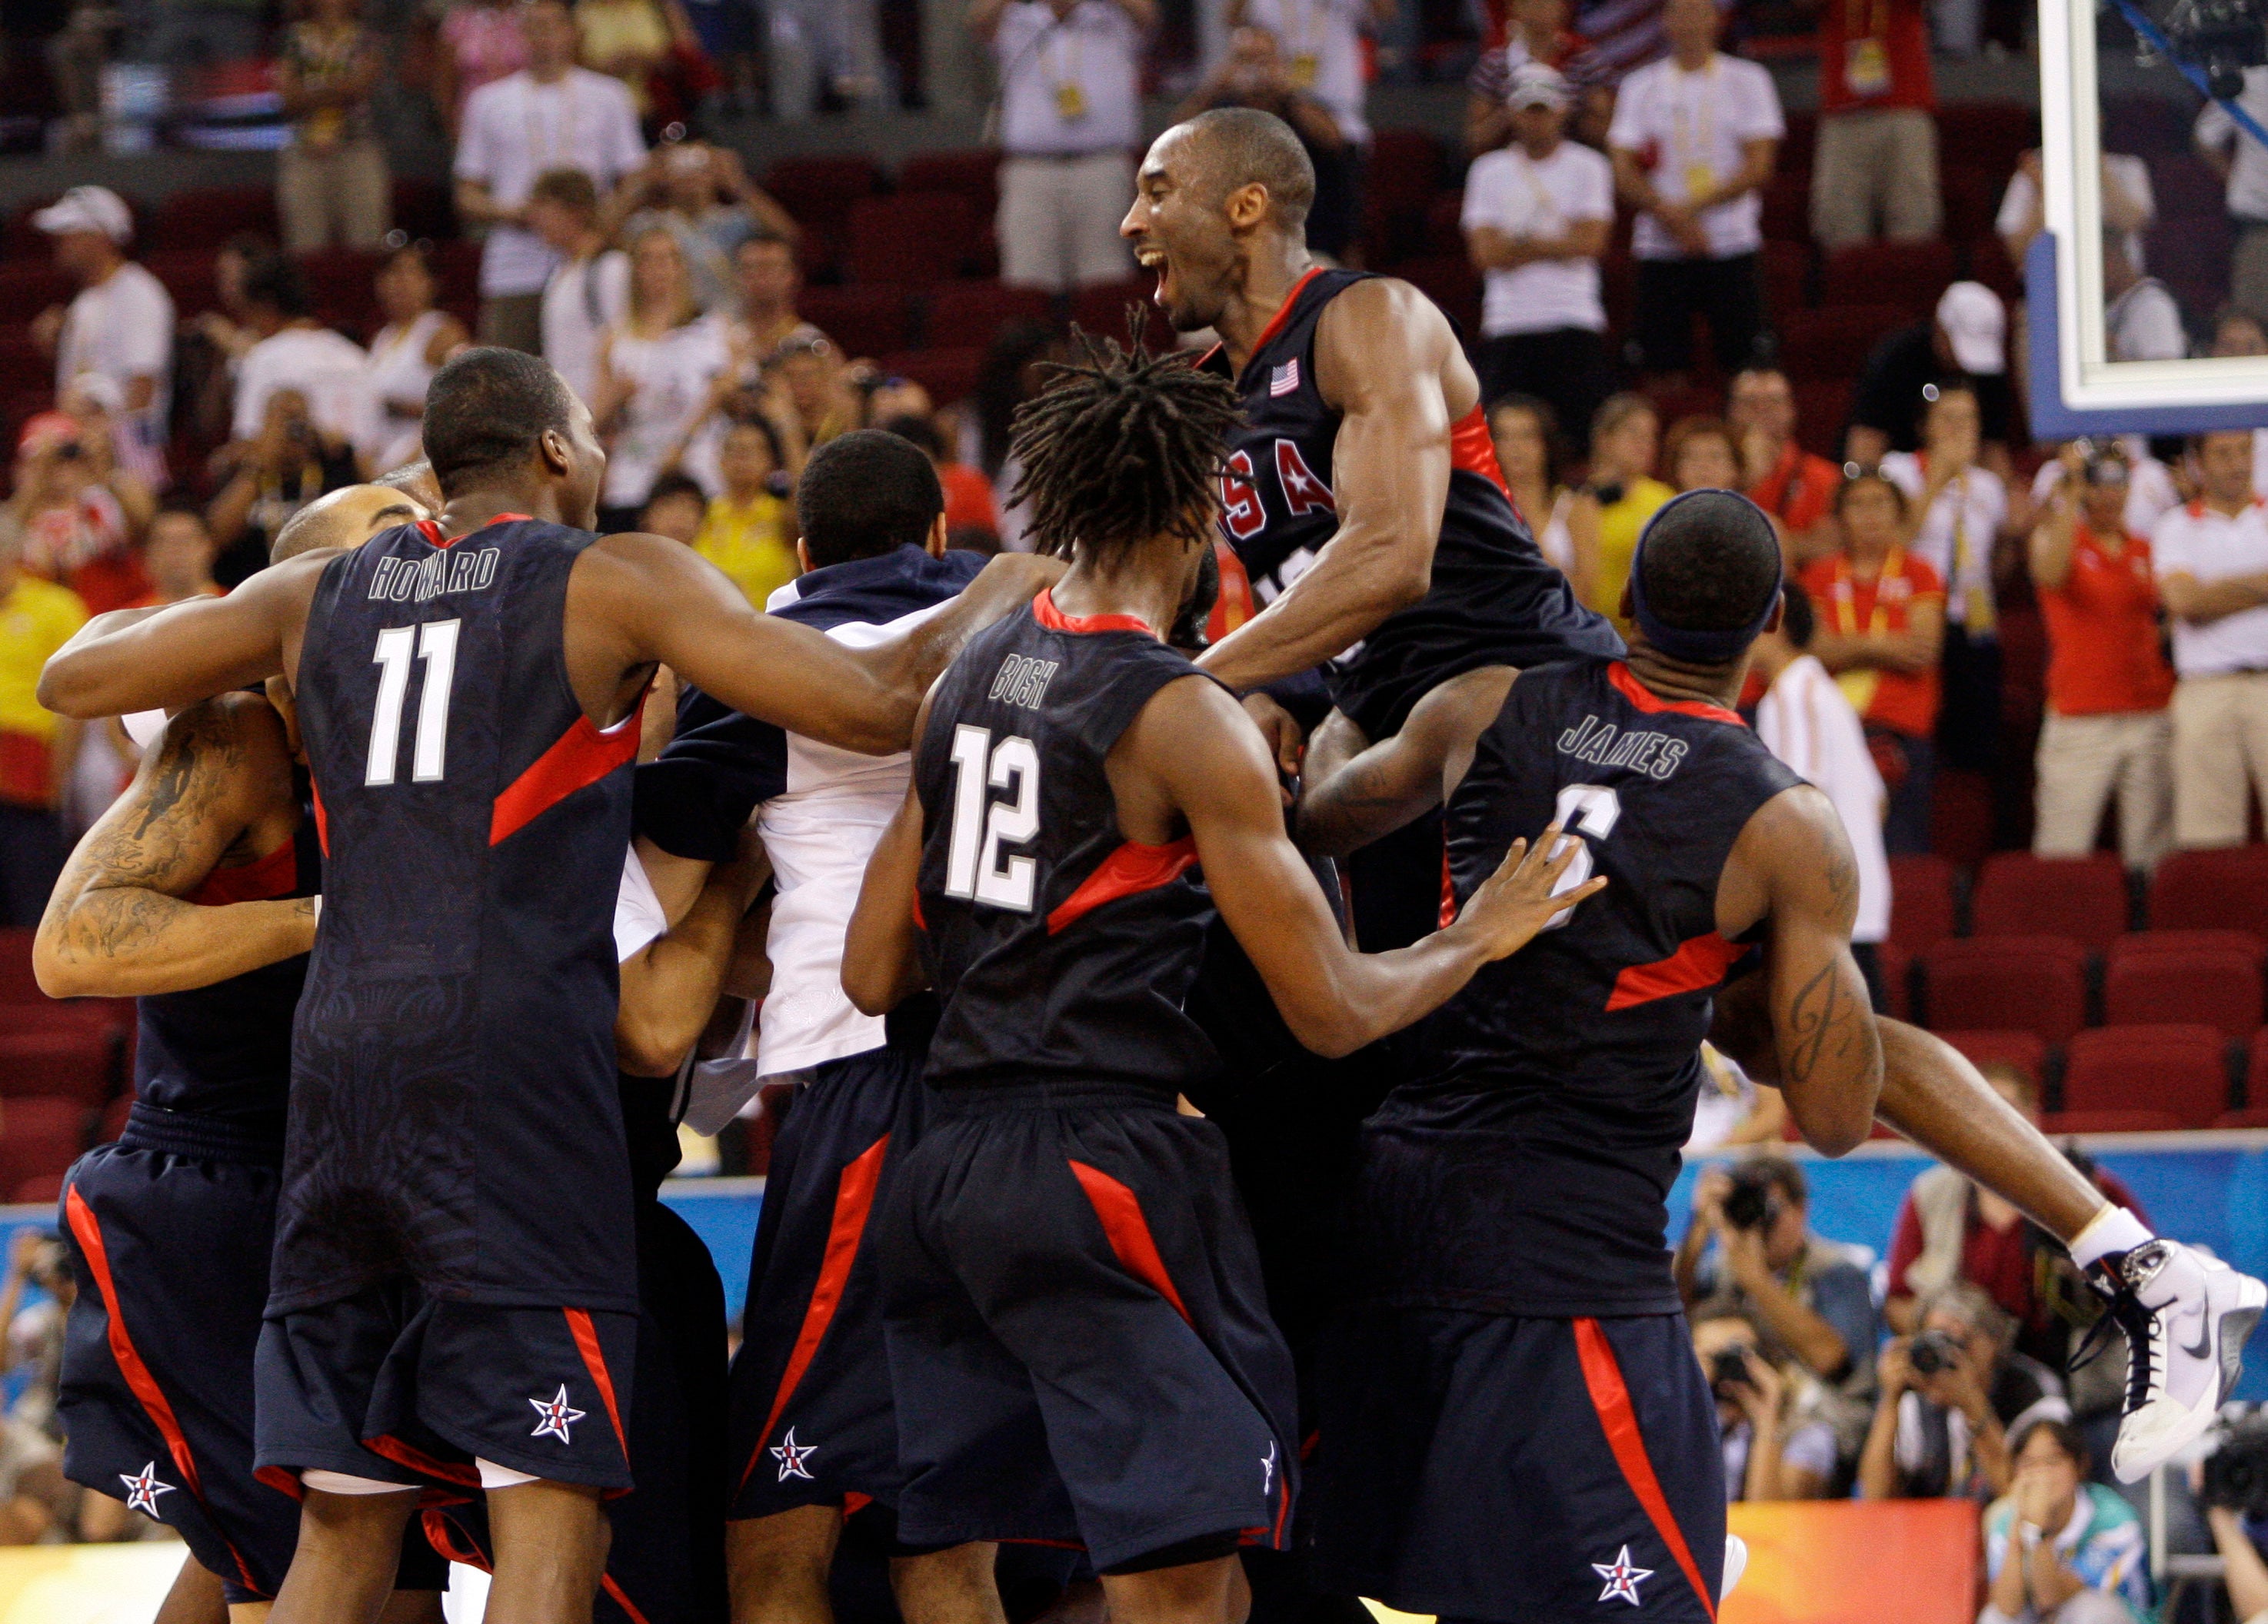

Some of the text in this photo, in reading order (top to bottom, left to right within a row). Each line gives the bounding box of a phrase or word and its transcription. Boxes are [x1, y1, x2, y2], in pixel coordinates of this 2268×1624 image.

[1217, 438, 1335, 541] SA
[367, 547, 501, 603] HOWARD
[364, 617, 461, 787] 11
[987, 653, 1059, 710] BOSH
[1557, 714, 1688, 780] JAMES
[944, 722, 1040, 913] 12
